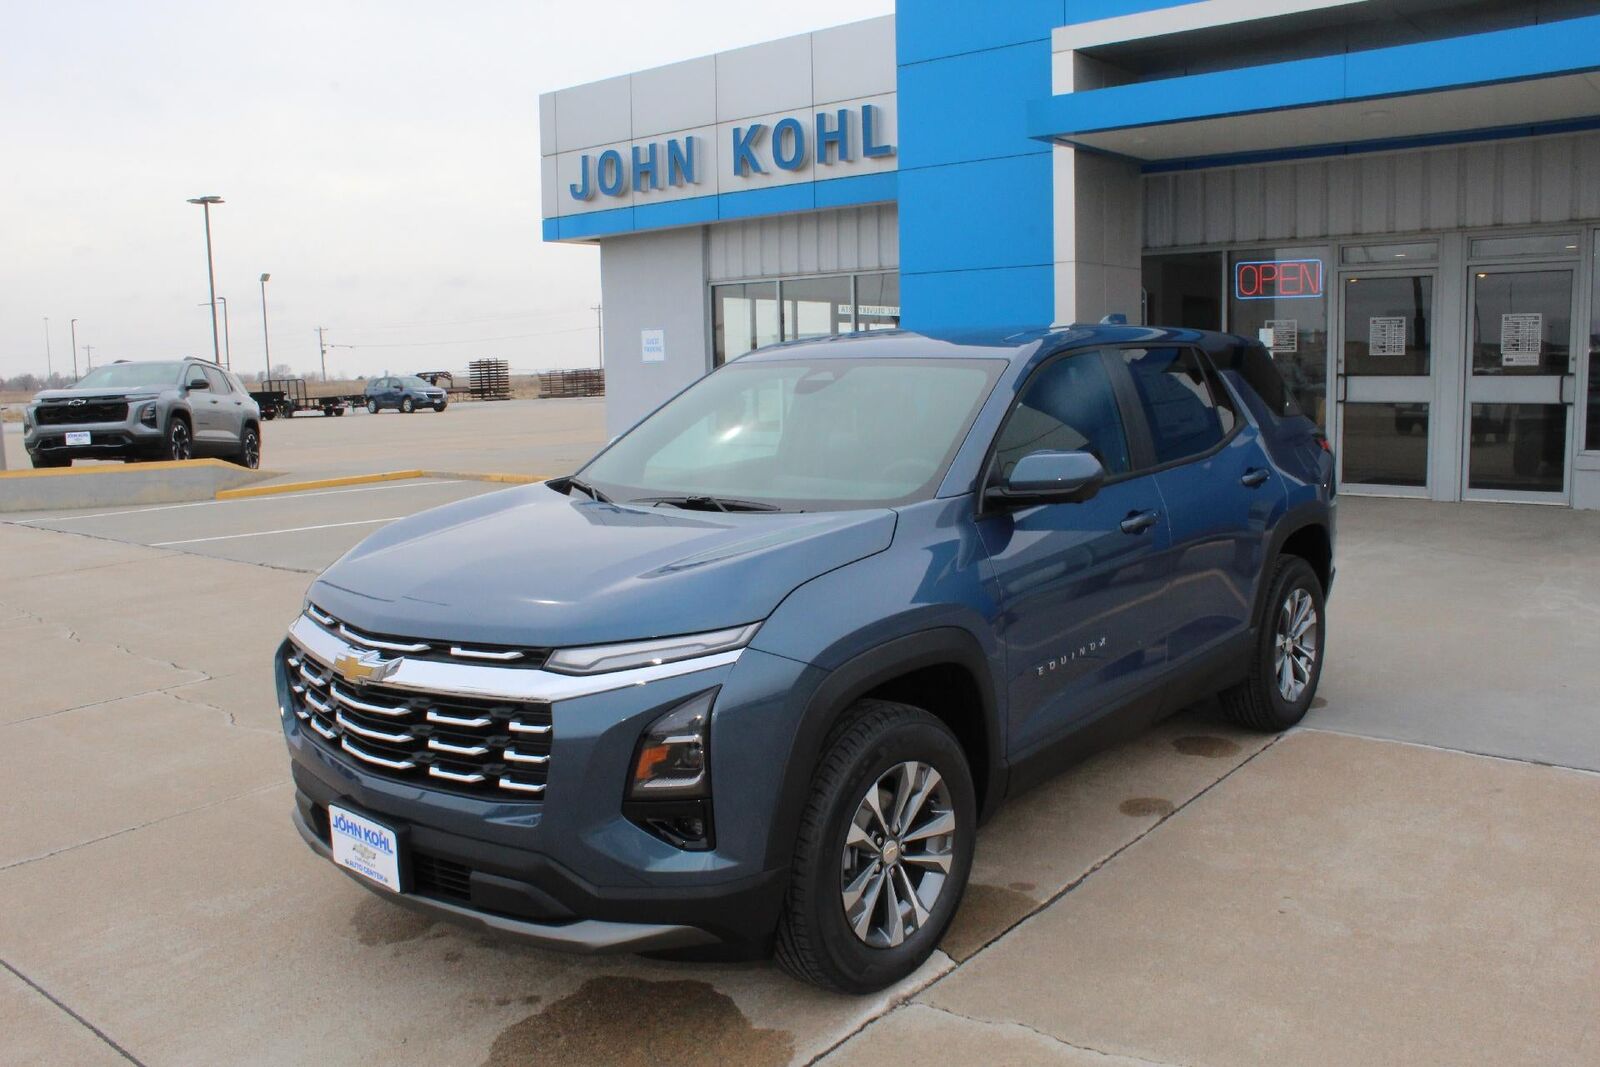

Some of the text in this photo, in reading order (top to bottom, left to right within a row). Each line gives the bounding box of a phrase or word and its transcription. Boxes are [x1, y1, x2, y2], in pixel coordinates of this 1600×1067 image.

[569, 104, 896, 202] JOHN KOHL
[1239, 263, 1319, 296] OPEN
[1038, 637, 1106, 676] EQUINOX
[333, 814, 394, 854] JOHN KOHL
